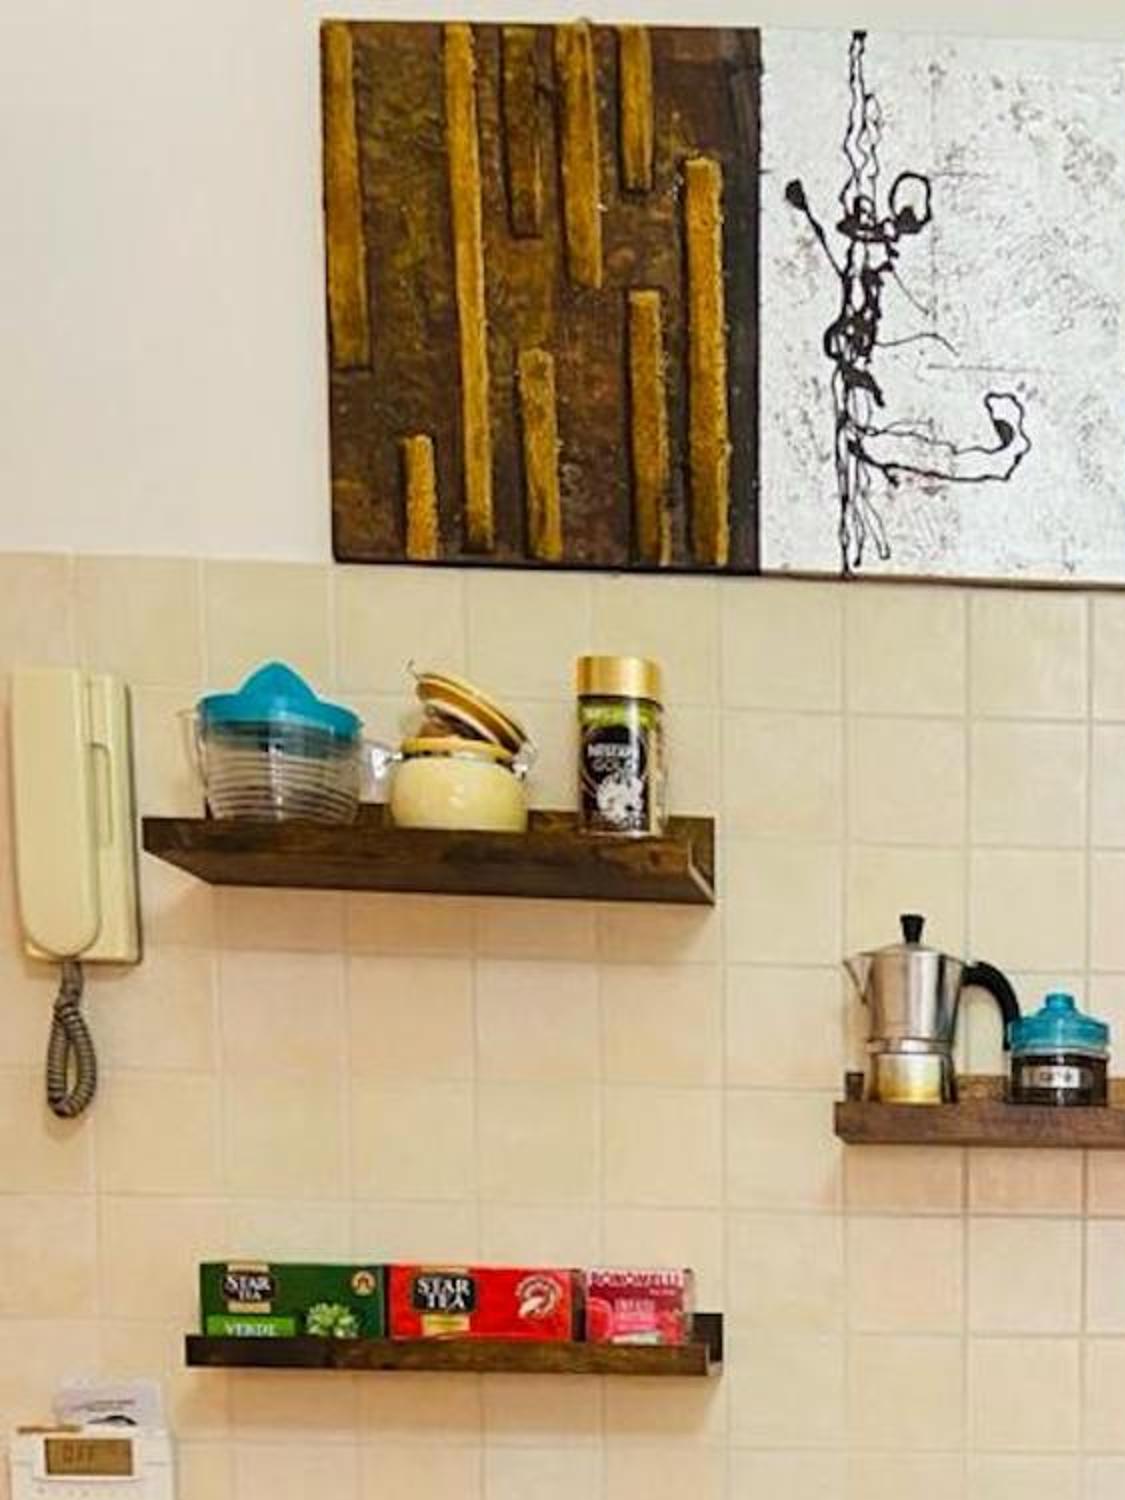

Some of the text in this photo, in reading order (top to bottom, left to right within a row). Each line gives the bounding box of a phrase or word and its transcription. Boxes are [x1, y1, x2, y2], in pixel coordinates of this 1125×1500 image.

[224, 1274, 272, 1291] STAR
[417, 1276, 471, 1296] STAR
[427, 1293, 467, 1310] TEA
